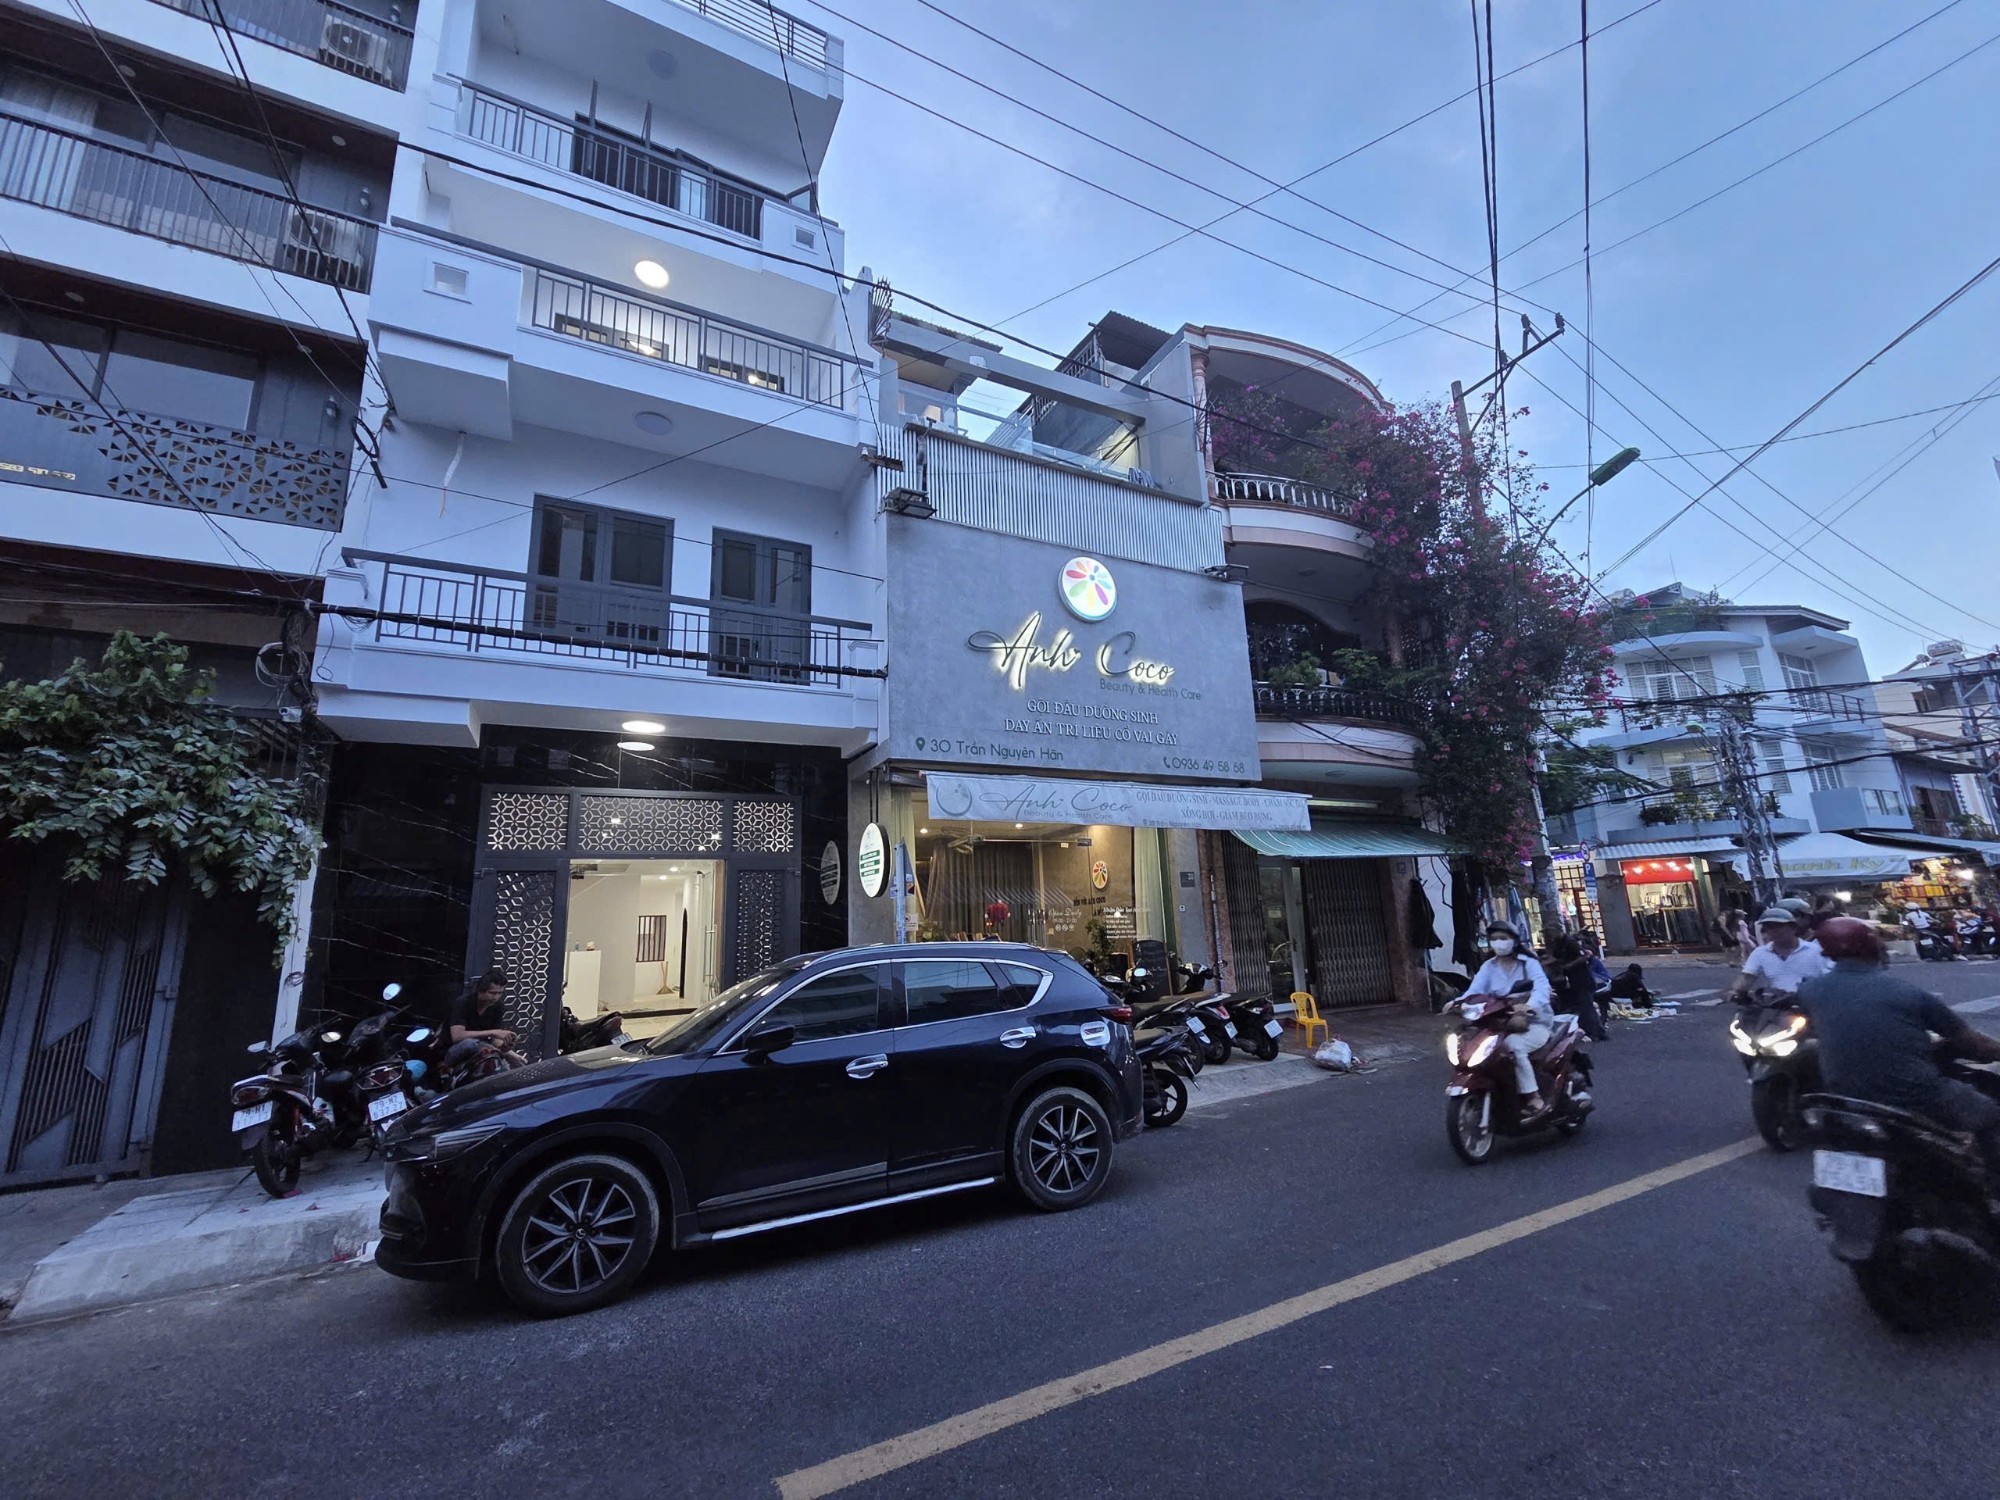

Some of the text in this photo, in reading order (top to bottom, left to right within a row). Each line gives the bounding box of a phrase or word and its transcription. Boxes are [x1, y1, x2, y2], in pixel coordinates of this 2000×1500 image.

[968, 611, 1175, 687] Anh Coco
[1100, 678, 1202, 700] Beauty & Health Care
[1130, 710, 1159, 724] SINH
[1133, 730, 1153, 743] VAI
[930, 739, 1063, 761] 30 Trần Nguyên Hãn
[1172, 757, 1245, 774] 0936 49 58 68
[979, 784, 1134, 820] Anh Coco
[1023, 809, 1113, 820] Beauty & Health Care
